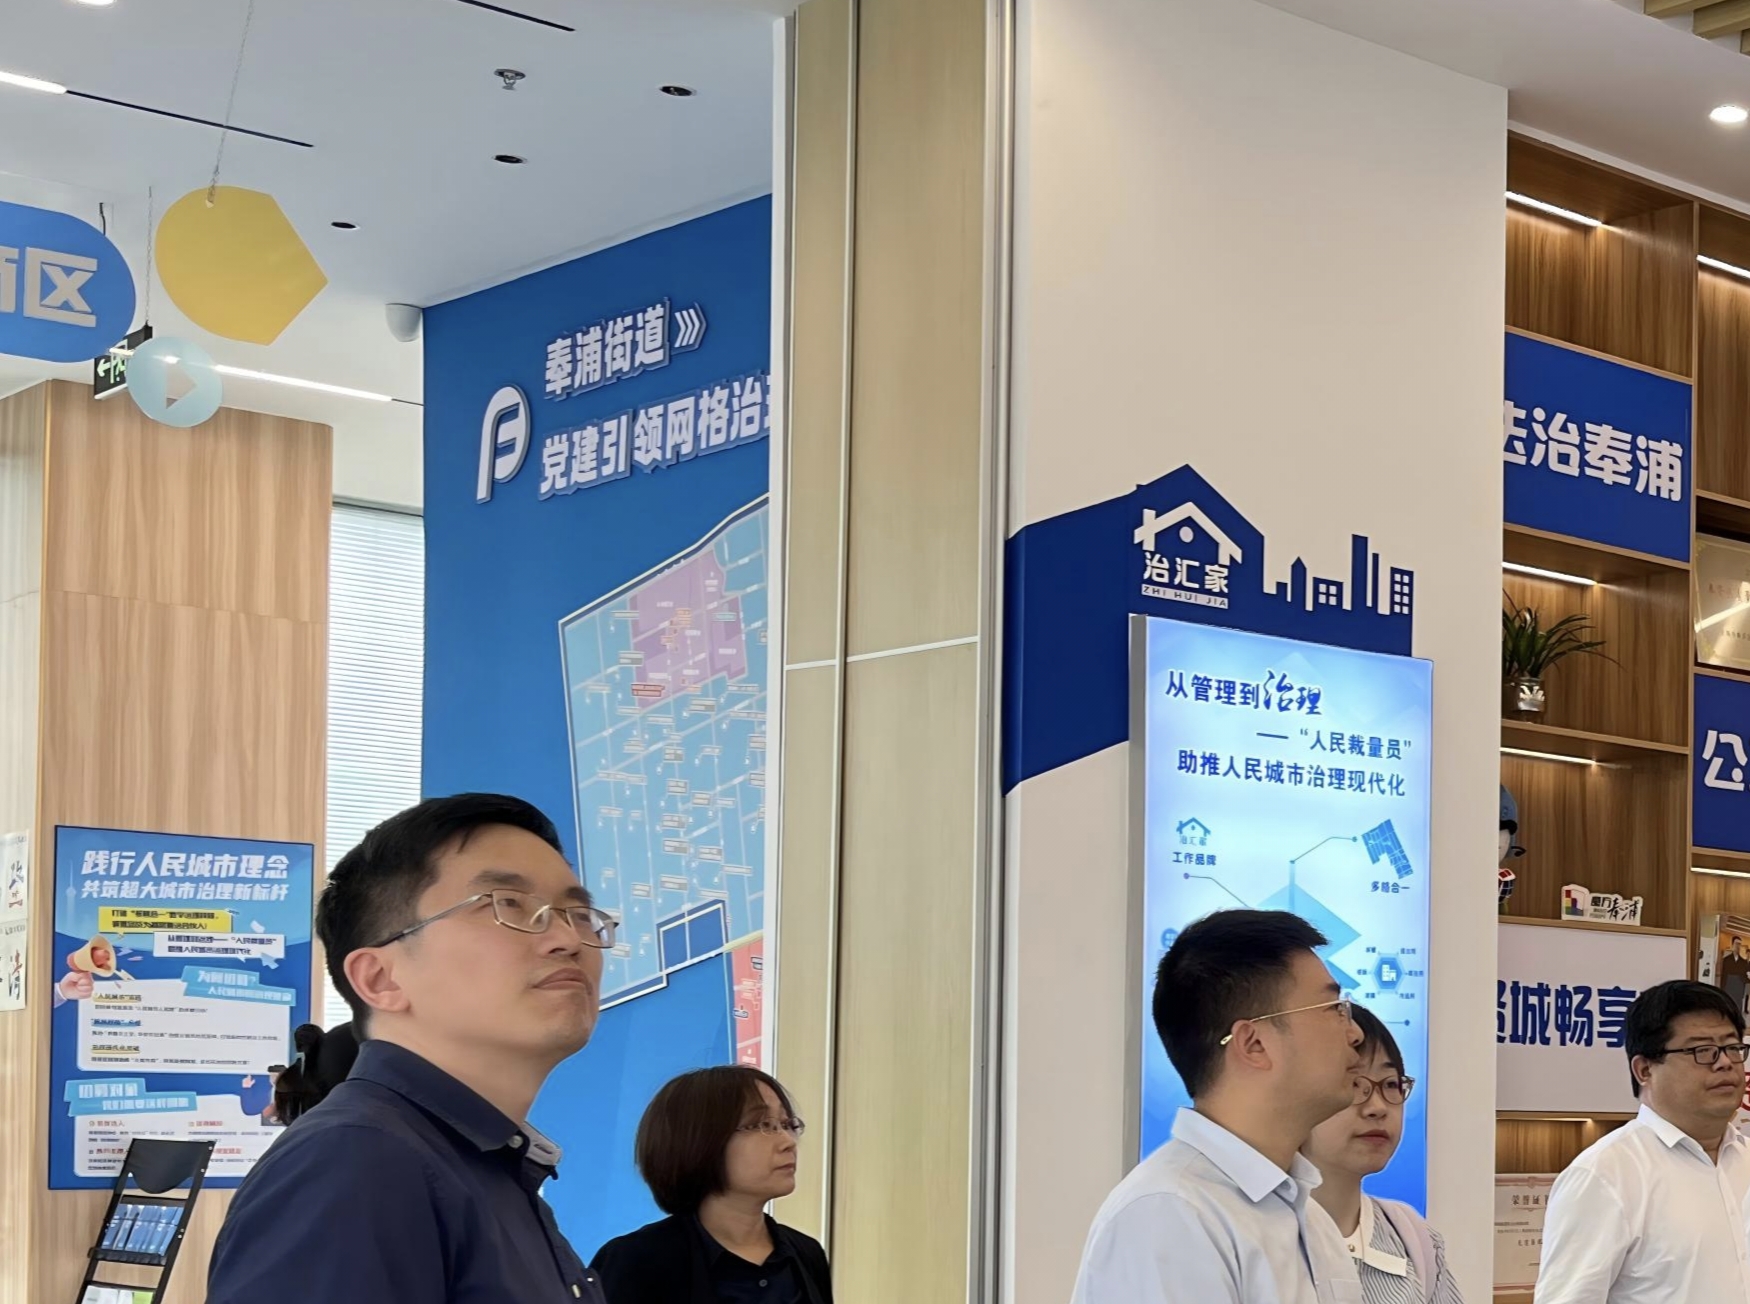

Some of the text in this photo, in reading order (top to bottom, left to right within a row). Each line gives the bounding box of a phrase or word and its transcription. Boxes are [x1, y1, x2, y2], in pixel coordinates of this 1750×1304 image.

[0, 246, 97, 327] 区
[545, 303, 665, 394] 奉浦街道
[540, 373, 769, 494] 党建引领网格治
[1143, 551, 1228, 593] 治汇家
[1143, 585, 1227, 607] ZHI HUI JIA
[1165, 670, 1322, 715] 从管理到治理
[1177, 750, 1406, 797] 助推人民城市治理现代化
[80, 850, 290, 880] 践行人民城市理念
[1172, 851, 1217, 866] 工作品牌
[80, 880, 290, 902] 共筑超大城市治理新标杆
